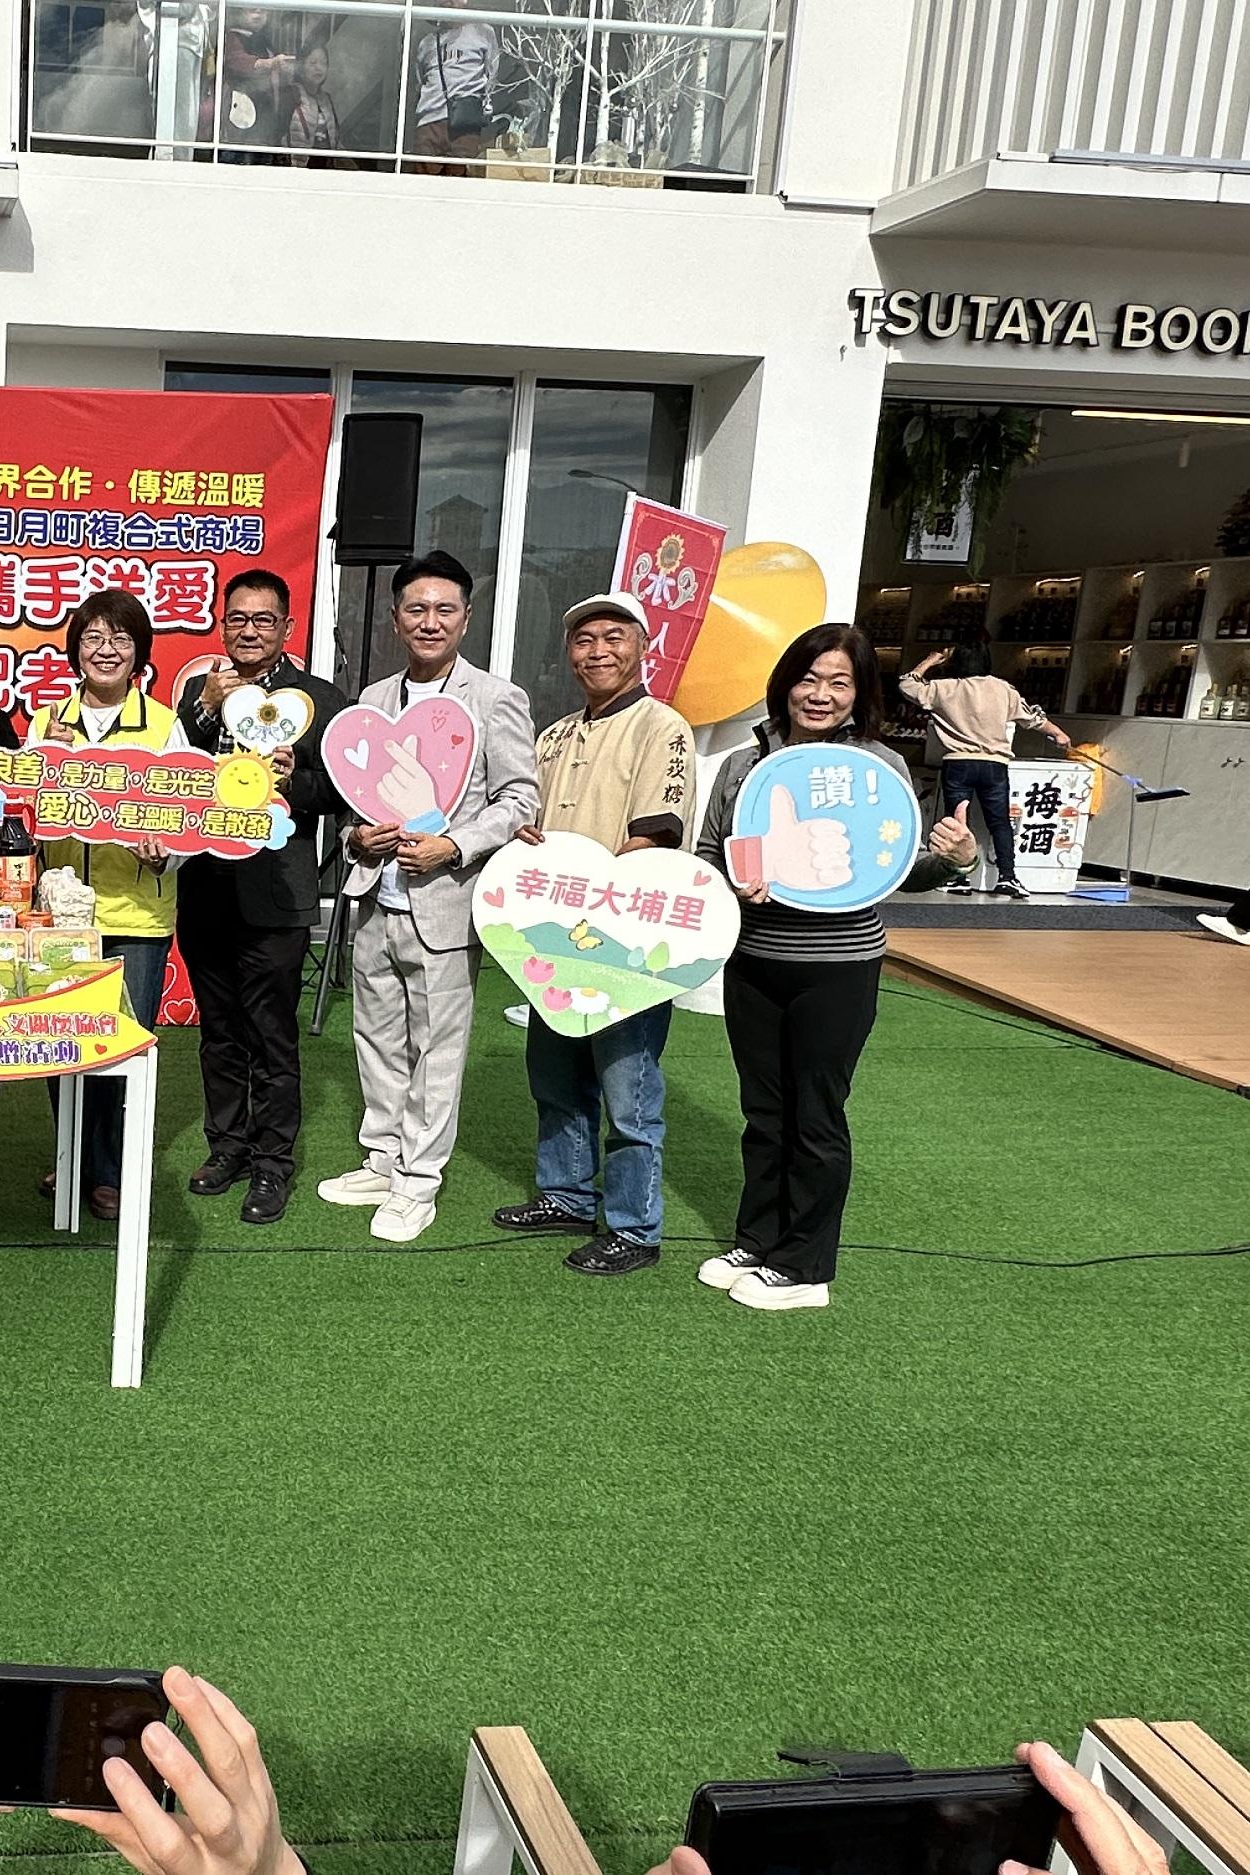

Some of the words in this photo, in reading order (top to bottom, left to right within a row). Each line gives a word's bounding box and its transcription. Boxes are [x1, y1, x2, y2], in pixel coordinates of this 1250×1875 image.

[852, 287, 1100, 348] TSUTAYA
[1019, 782, 1063, 855] 梅酒
[515, 868, 706, 931] 幸福大埔里
